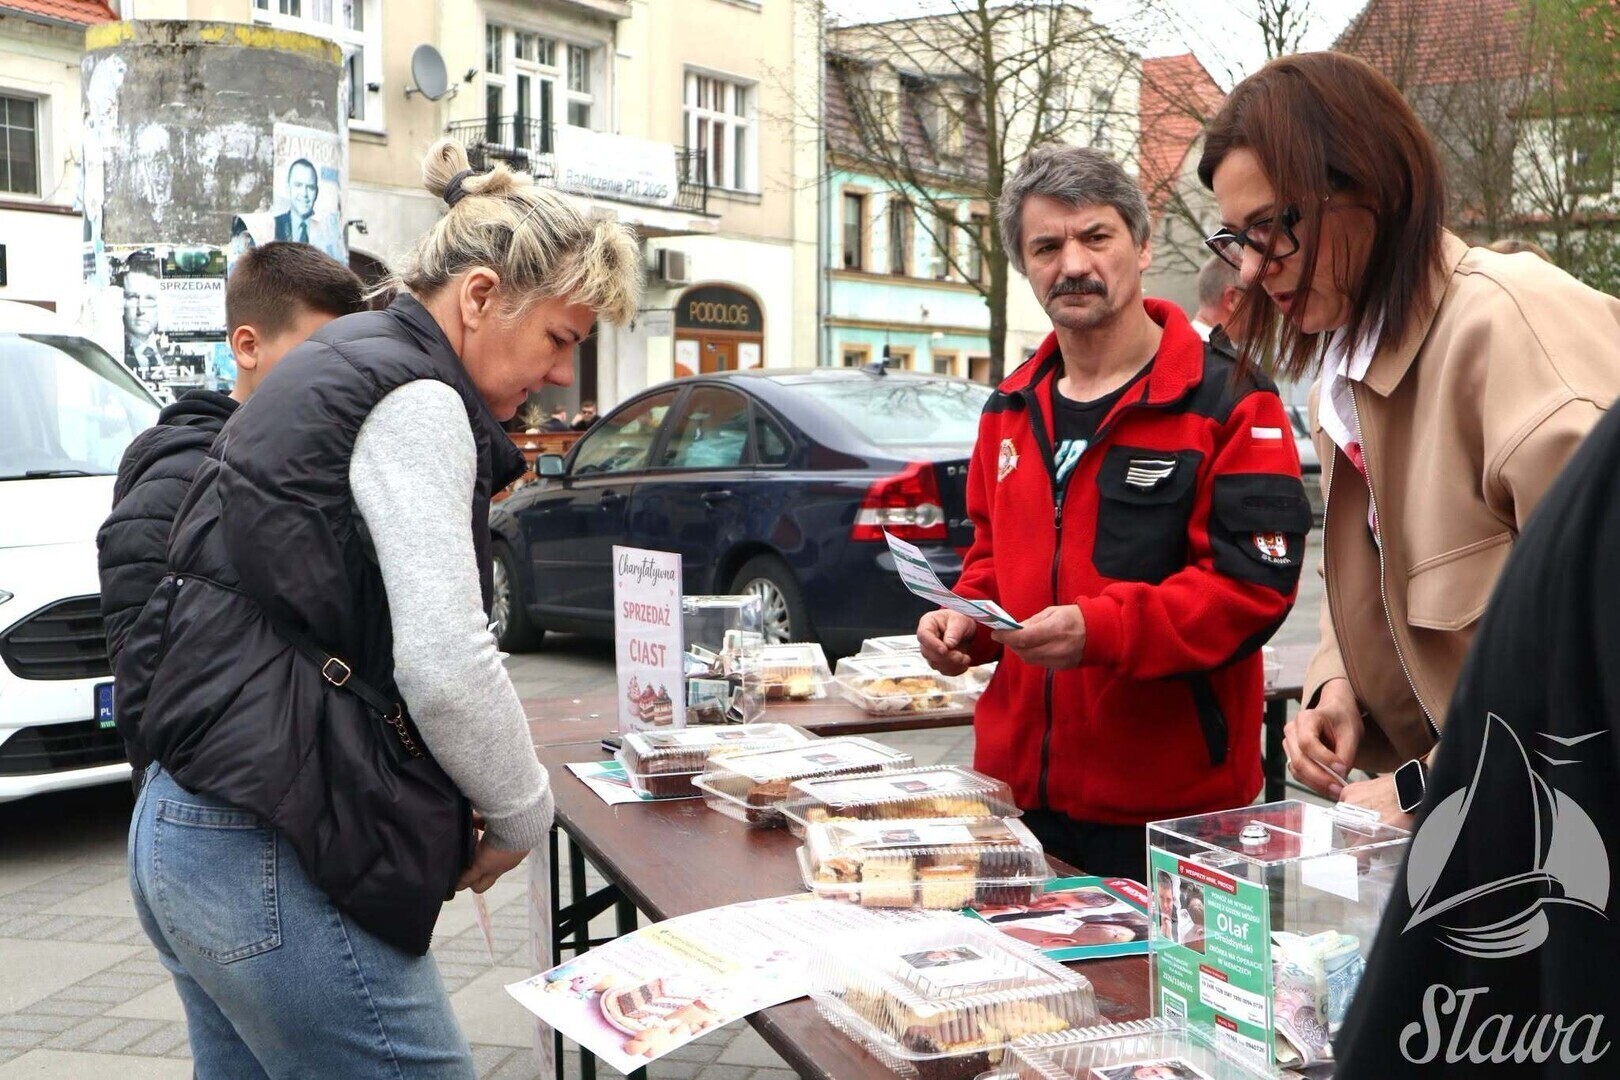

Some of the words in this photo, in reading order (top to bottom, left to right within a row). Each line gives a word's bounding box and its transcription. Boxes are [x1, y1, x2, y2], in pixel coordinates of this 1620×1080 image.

[566, 169, 623, 192] Rozliczenie
[160, 281, 221, 291] SPRZEDAM
[689, 301, 749, 325] PODOLOG
[132, 365, 195, 380] TZEN
[618, 553, 676, 586] Charytatywna
[623, 601, 671, 627] SPRZEDAŻ
[629, 638, 667, 668] CIAST
[100, 707, 111, 717] PL
[1216, 913, 1250, 940] Olaf
